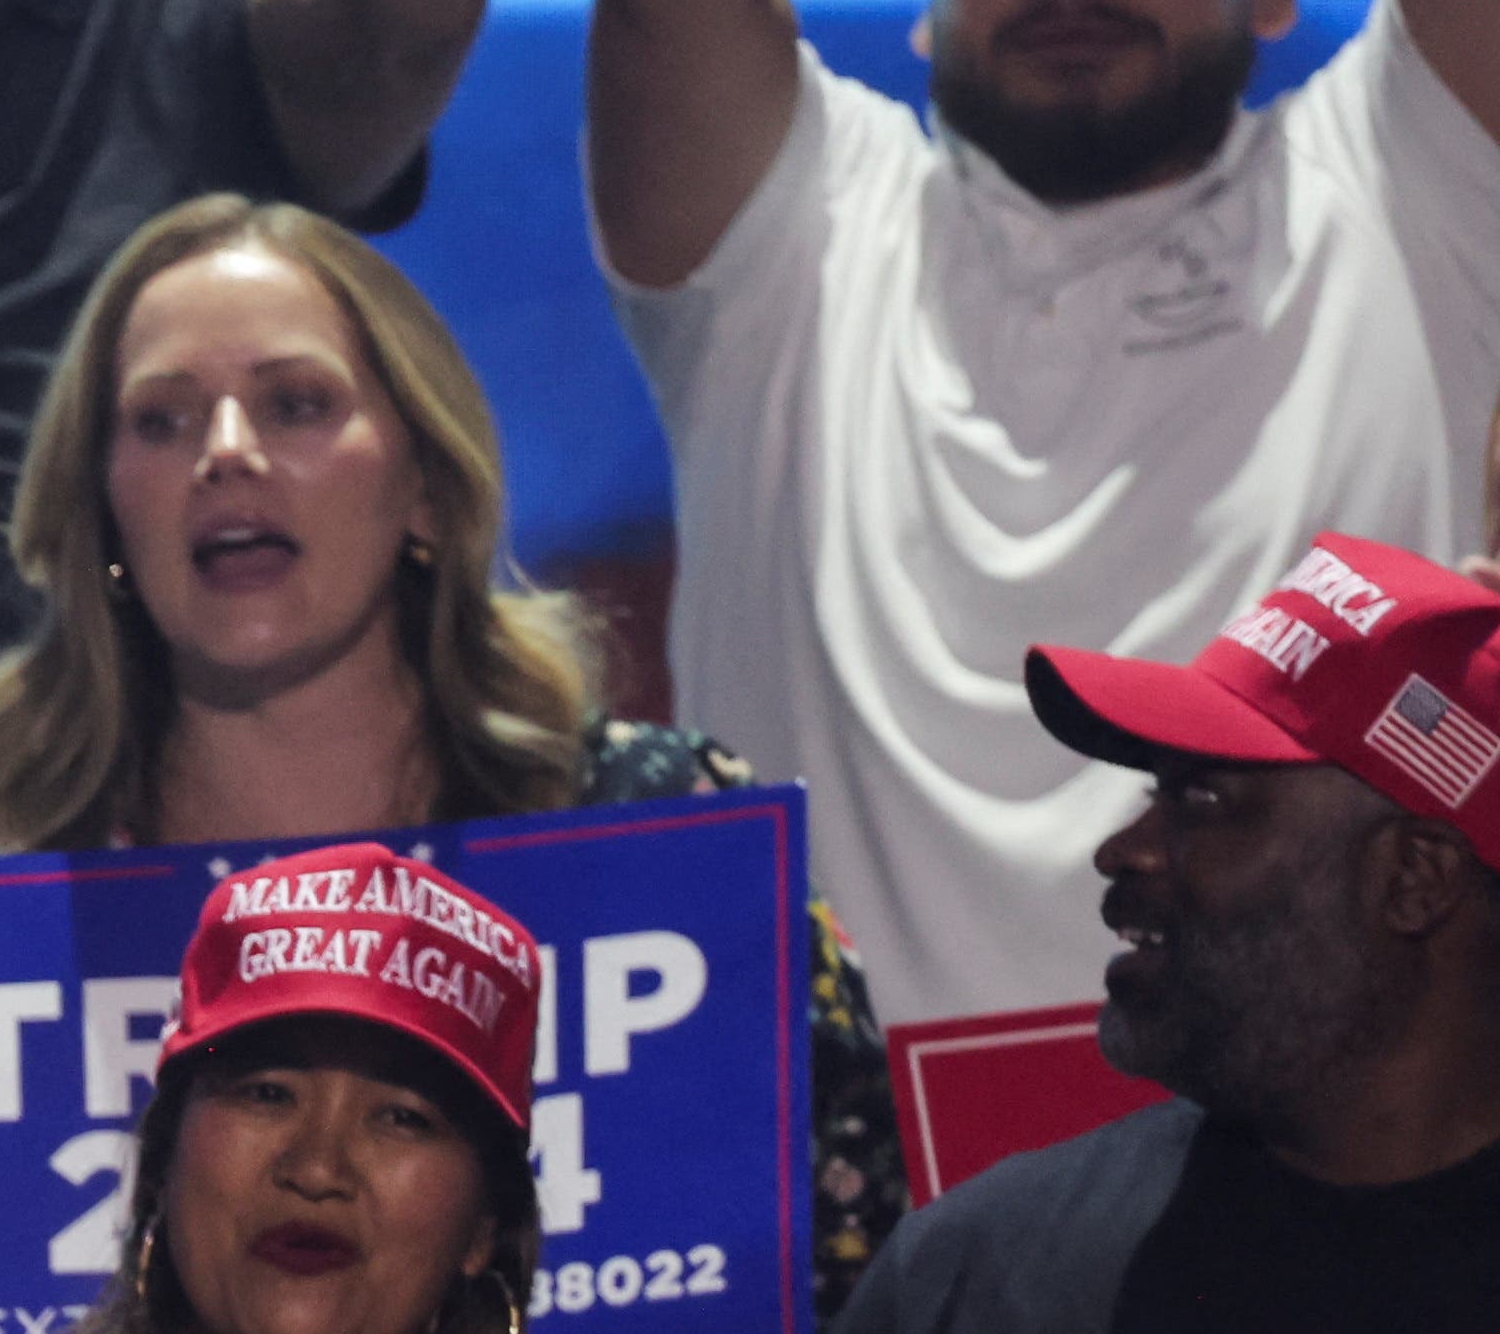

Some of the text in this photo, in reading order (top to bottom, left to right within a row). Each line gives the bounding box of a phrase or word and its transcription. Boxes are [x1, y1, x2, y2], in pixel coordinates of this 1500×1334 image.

[222, 866, 534, 990] MAKE AMERICA
[238, 927, 506, 1032] GREAT AGAIN
[47, 1091, 603, 1275] 24
